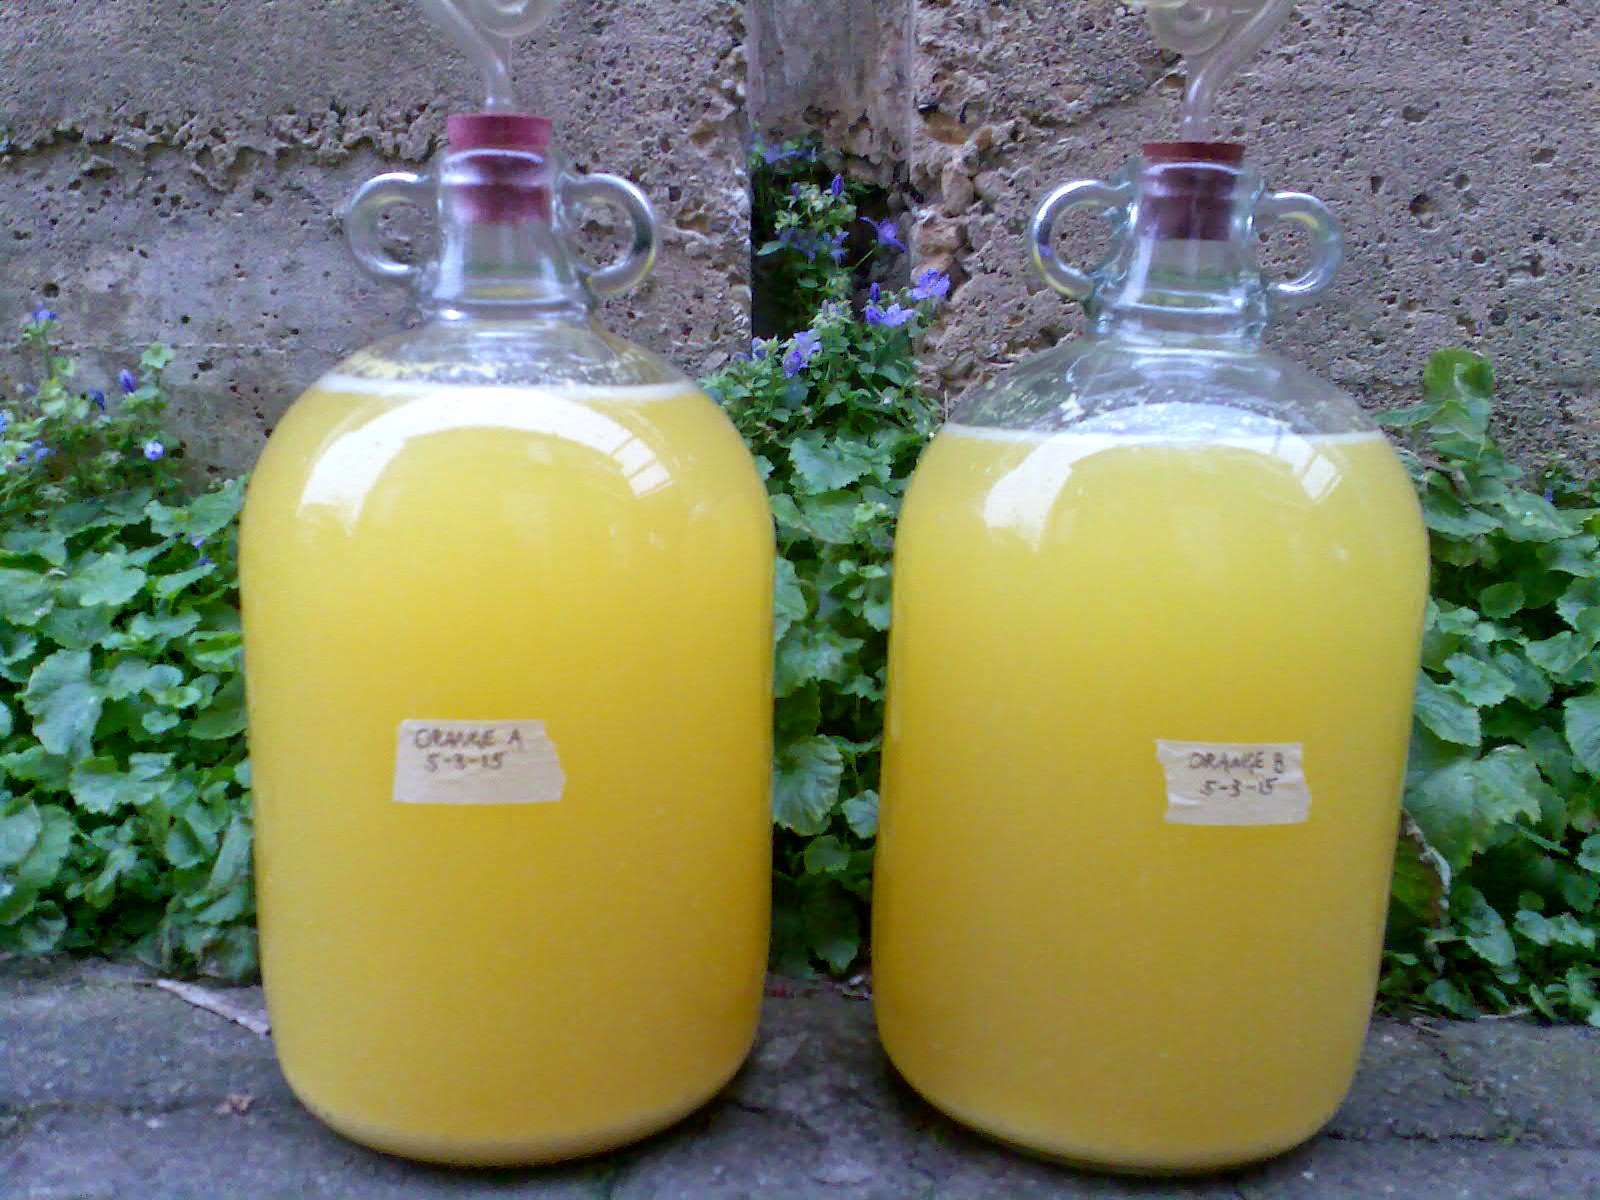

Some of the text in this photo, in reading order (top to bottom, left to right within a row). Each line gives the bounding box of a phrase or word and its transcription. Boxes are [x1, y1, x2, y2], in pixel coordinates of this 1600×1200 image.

[507, 727, 524, 750] A
[1189, 751, 1285, 774] ORANGE B
